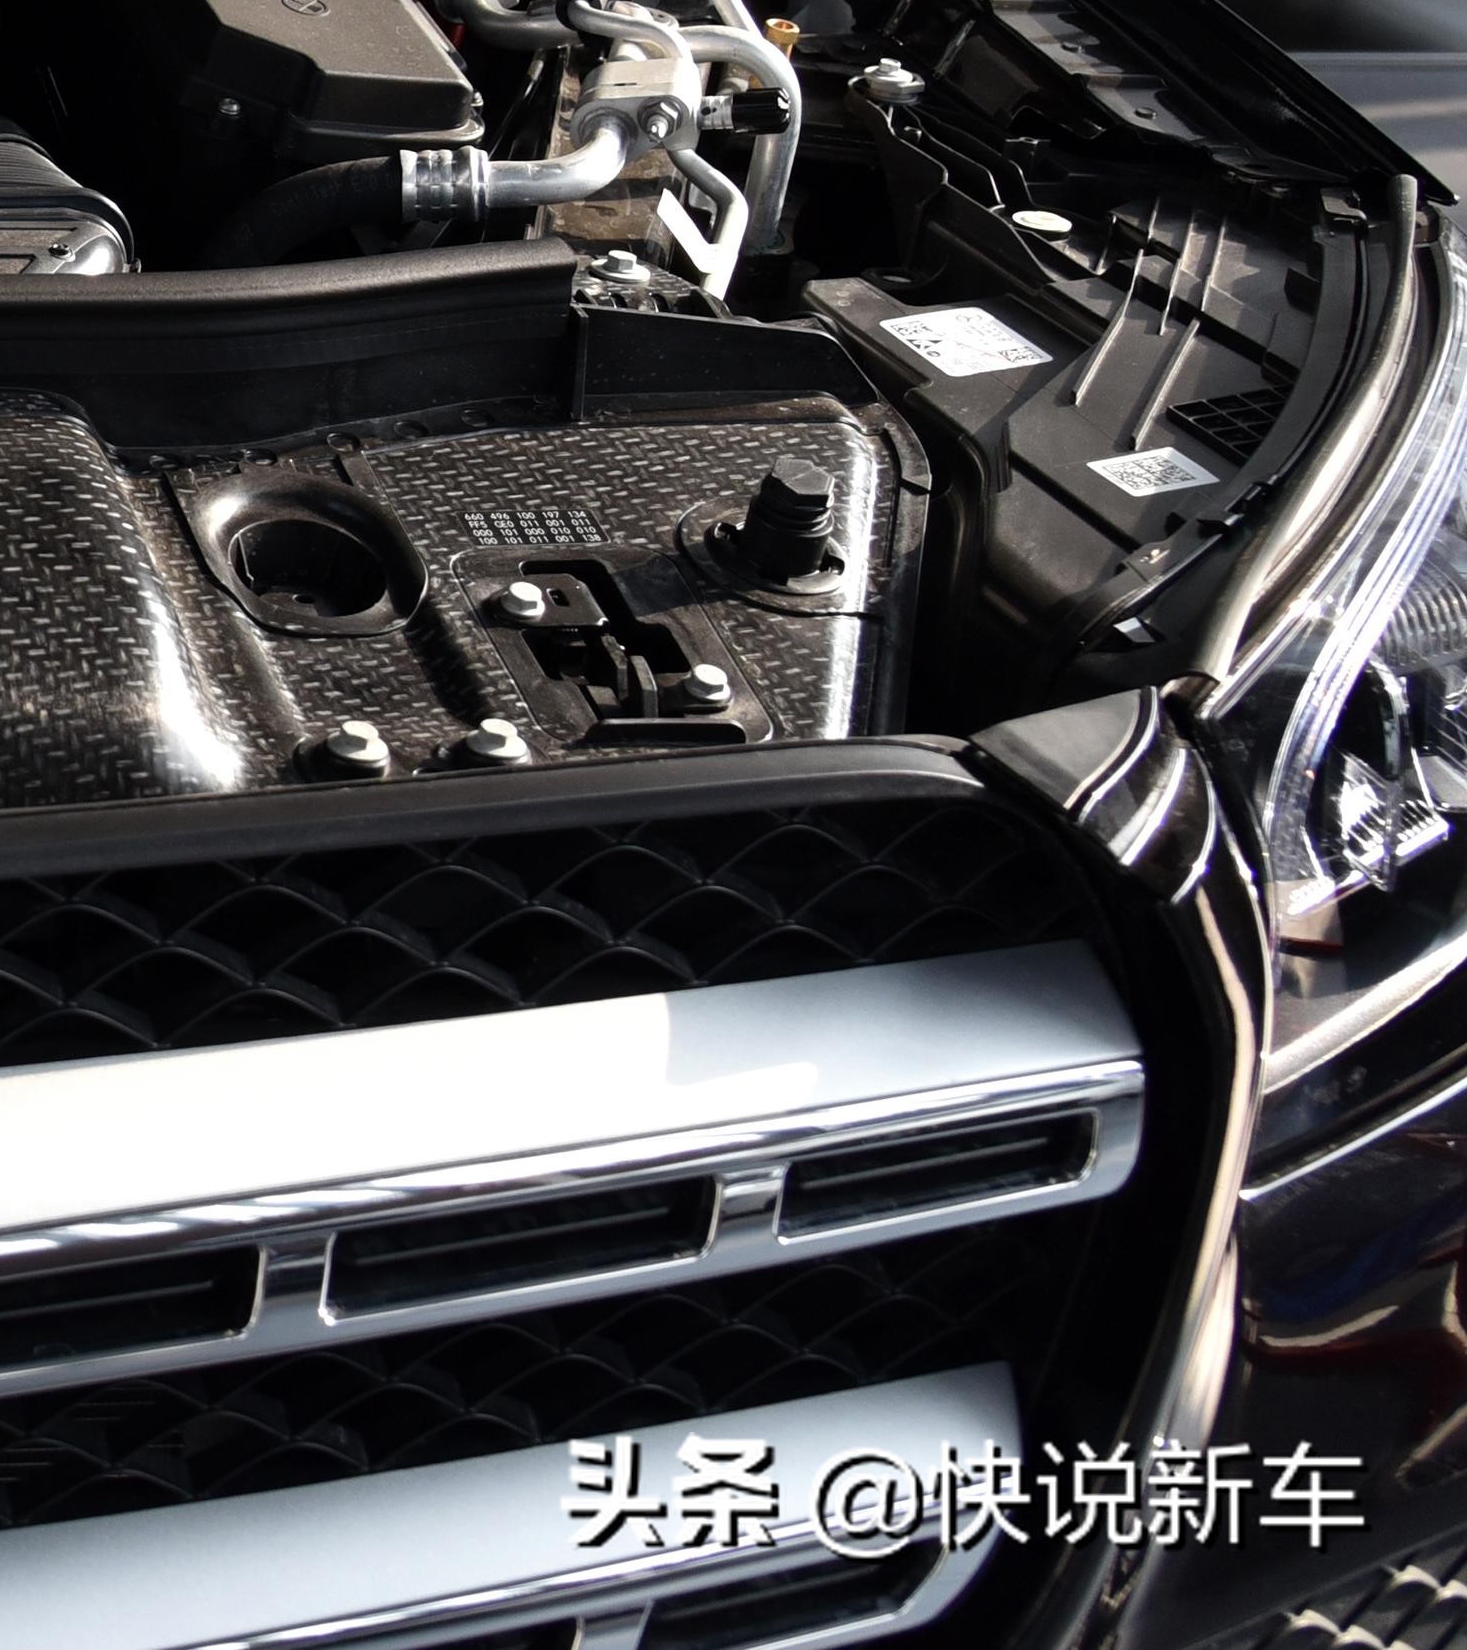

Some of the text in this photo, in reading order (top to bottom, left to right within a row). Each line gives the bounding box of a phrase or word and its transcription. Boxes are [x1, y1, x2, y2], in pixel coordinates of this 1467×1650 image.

[516, 511, 535, 519] 100
[541, 510, 558, 518] 197
[567, 510, 586, 518] 134
[519, 519, 539, 527] 011
[545, 518, 565, 526] 001
[472, 528, 493, 536] 000
[524, 527, 545, 535] 000
[549, 526, 570, 534] 010
[575, 525, 596, 534] 010
[478, 536, 498, 544] 100
[528, 535, 549, 543] 011
[554, 534, 575, 542] 001
